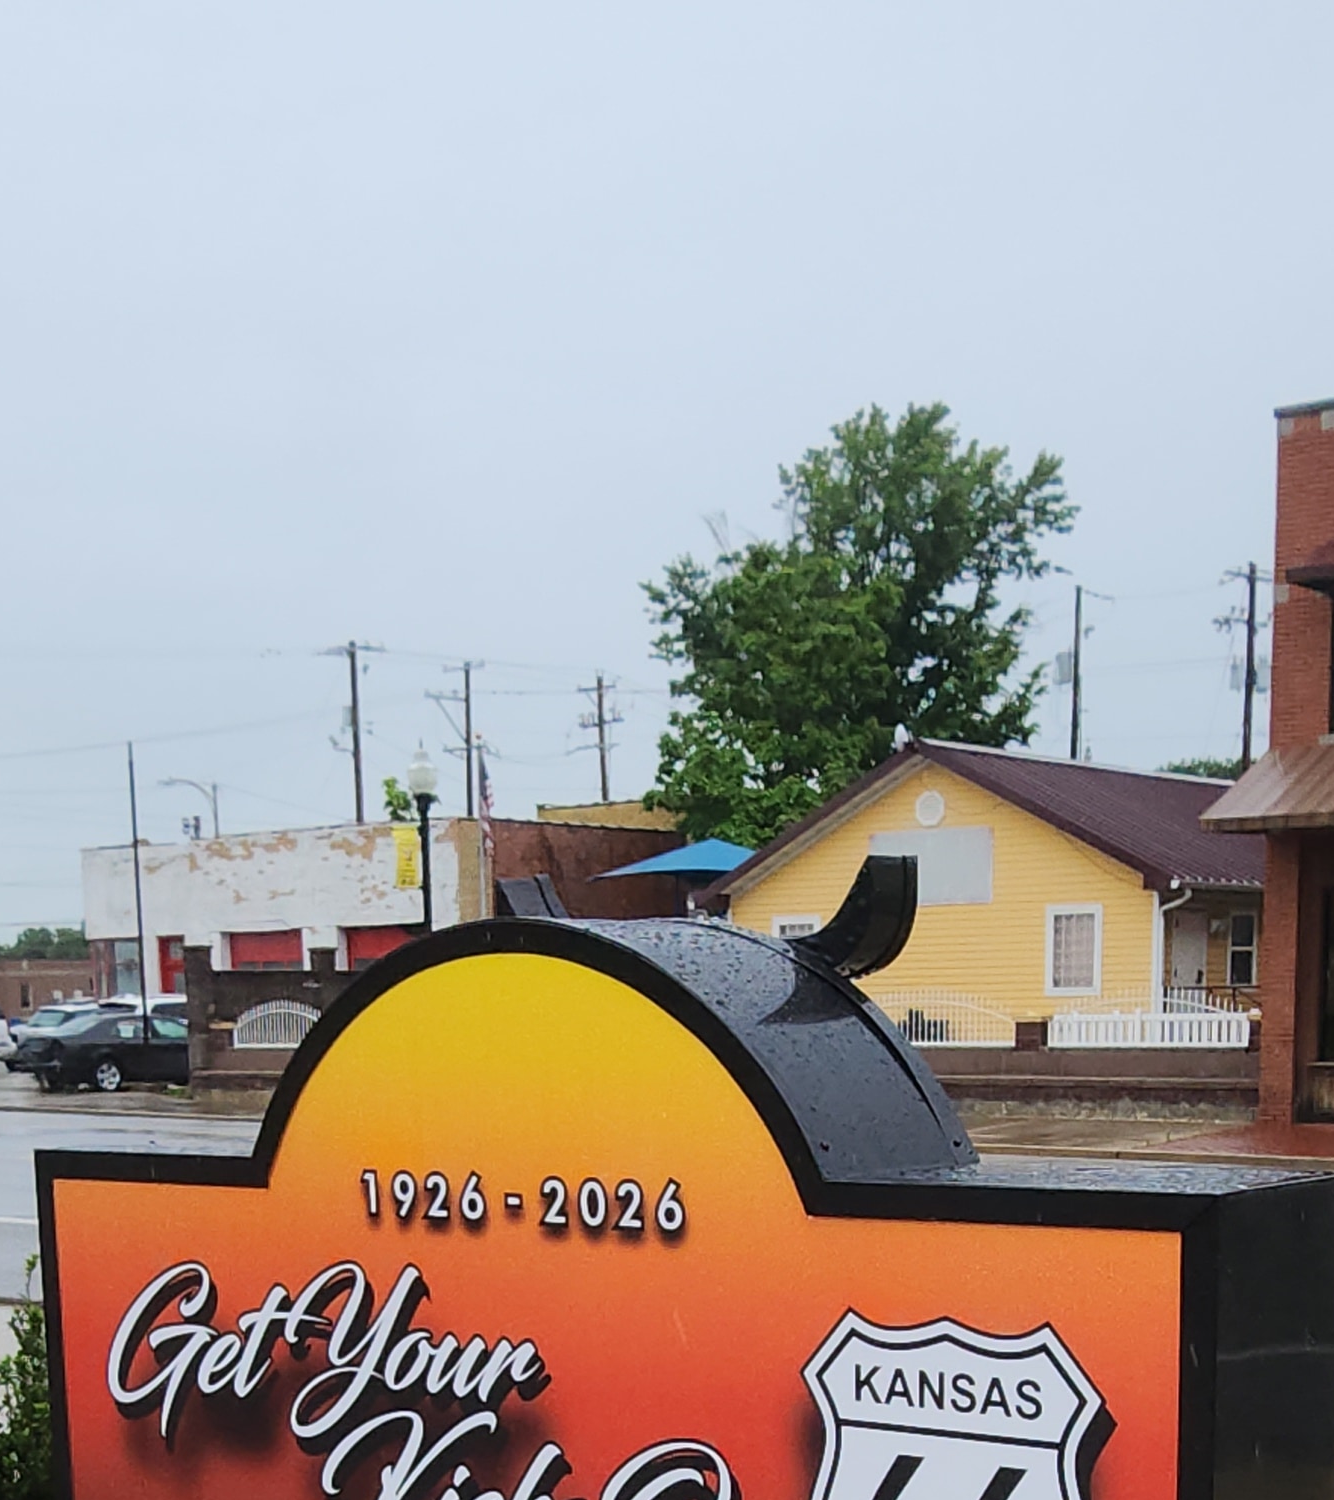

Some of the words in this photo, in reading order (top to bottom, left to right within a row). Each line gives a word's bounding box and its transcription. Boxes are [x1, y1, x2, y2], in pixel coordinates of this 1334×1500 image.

[107, 1261, 317, 1438] Get
[285, 1261, 545, 1438] Your
[853, 1362, 1043, 1421] KANSAS
